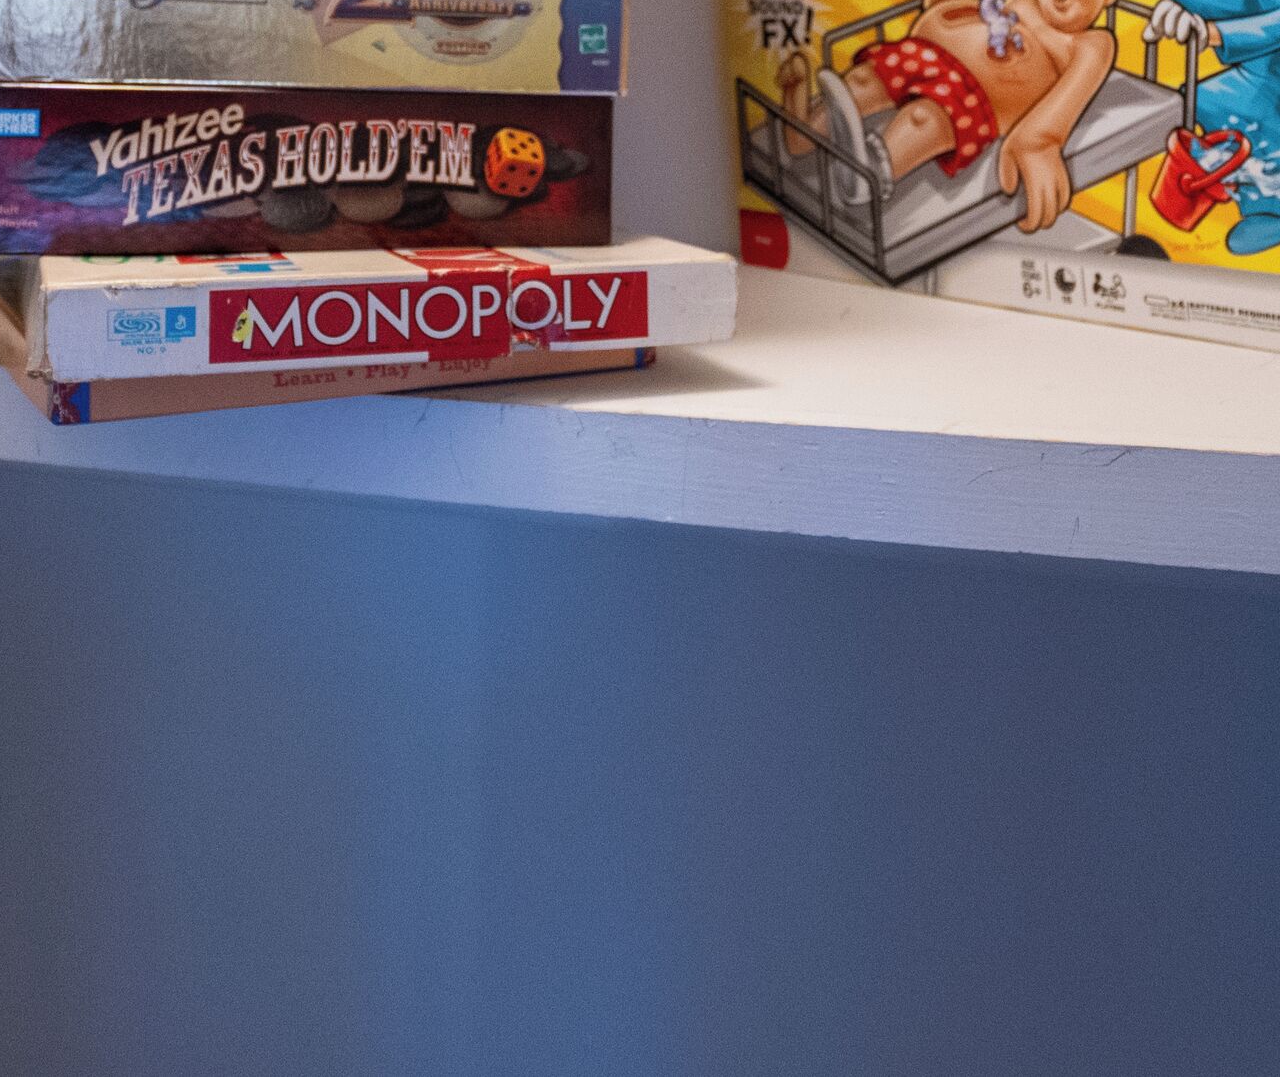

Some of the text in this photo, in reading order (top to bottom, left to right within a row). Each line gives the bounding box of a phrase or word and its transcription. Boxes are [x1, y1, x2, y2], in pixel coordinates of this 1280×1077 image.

[761, 6, 814, 49] FX!
[89, 103, 245, 177] Yahtzee
[121, 118, 477, 226] TEXAS HOLD'EM
[241, 277, 623, 350] MONOPOLY
[274, 370, 337, 388] Learn
[365, 362, 412, 379] Play
